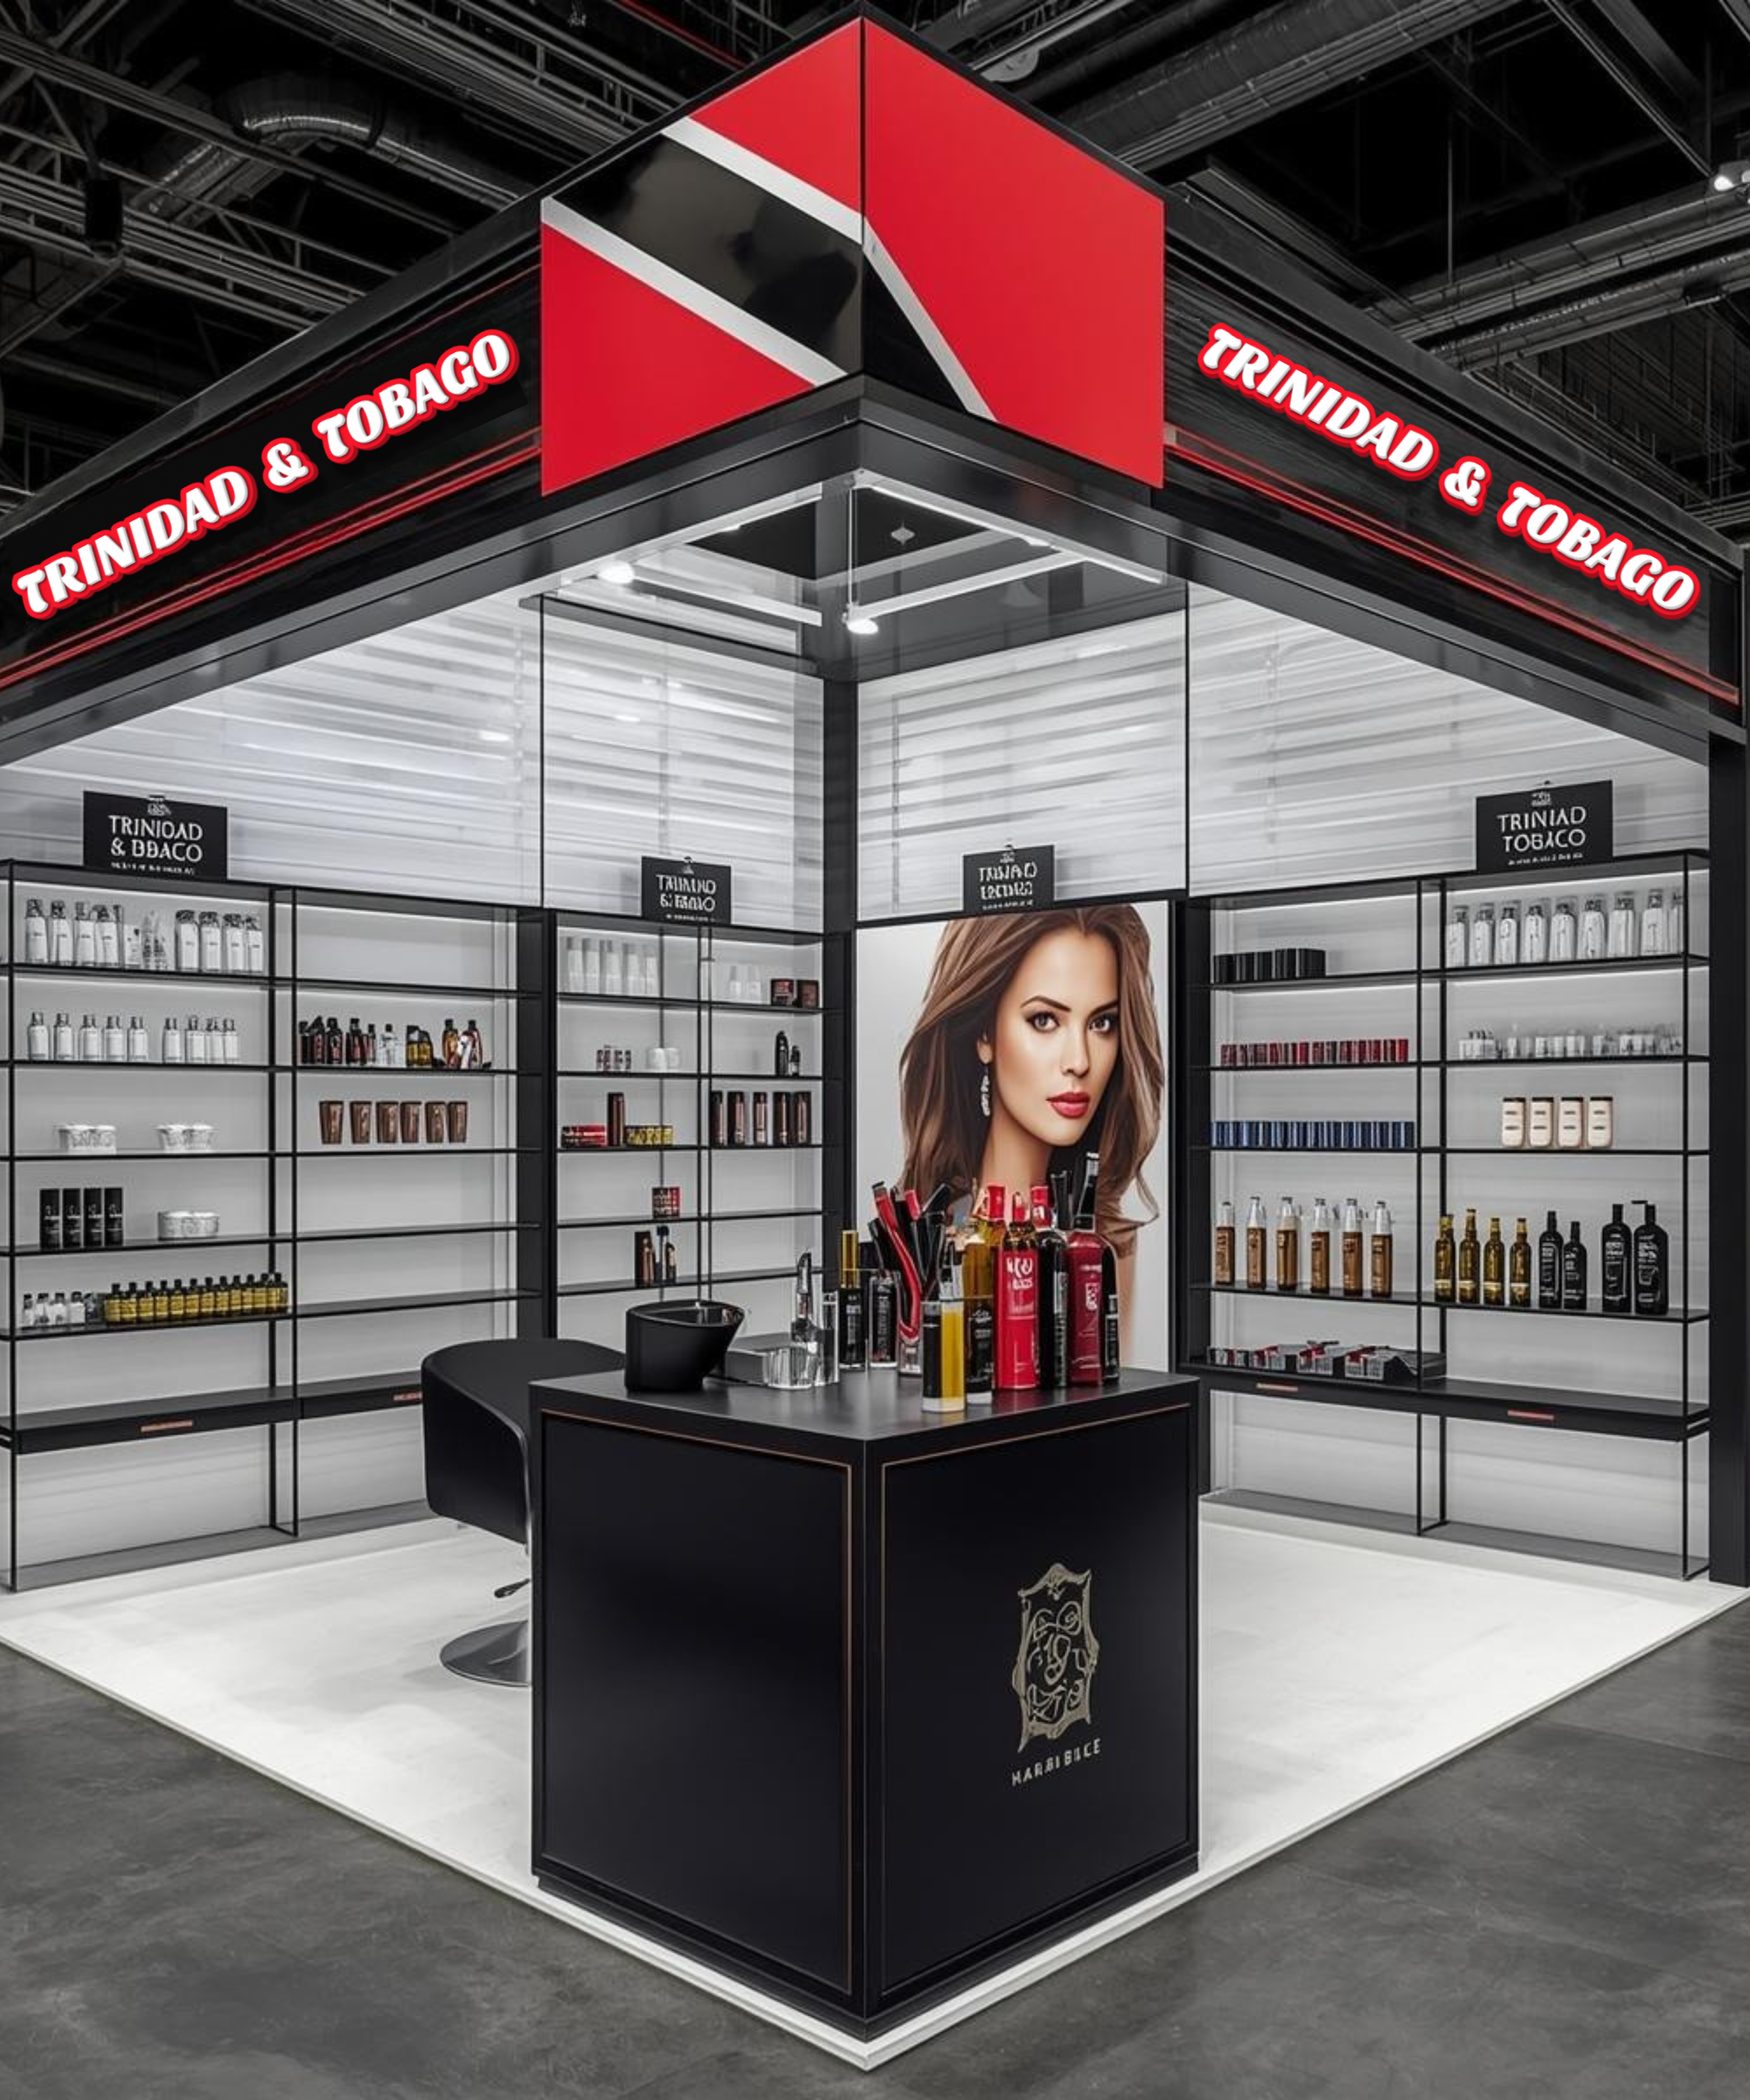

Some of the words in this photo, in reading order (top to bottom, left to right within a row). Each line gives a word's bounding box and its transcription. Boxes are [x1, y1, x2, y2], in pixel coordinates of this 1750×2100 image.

[13, 466, 256, 619] TRINIDAD
[261, 438, 318, 492] &
[312, 330, 519, 463] TOBAGO
[1198, 323, 1439, 481] TRINIDAD
[1439, 456, 1492, 516] &
[1497, 481, 1700, 620] TOBAGO
[111, 837, 126, 857] &
[1497, 806, 1586, 832] TRINIAD
